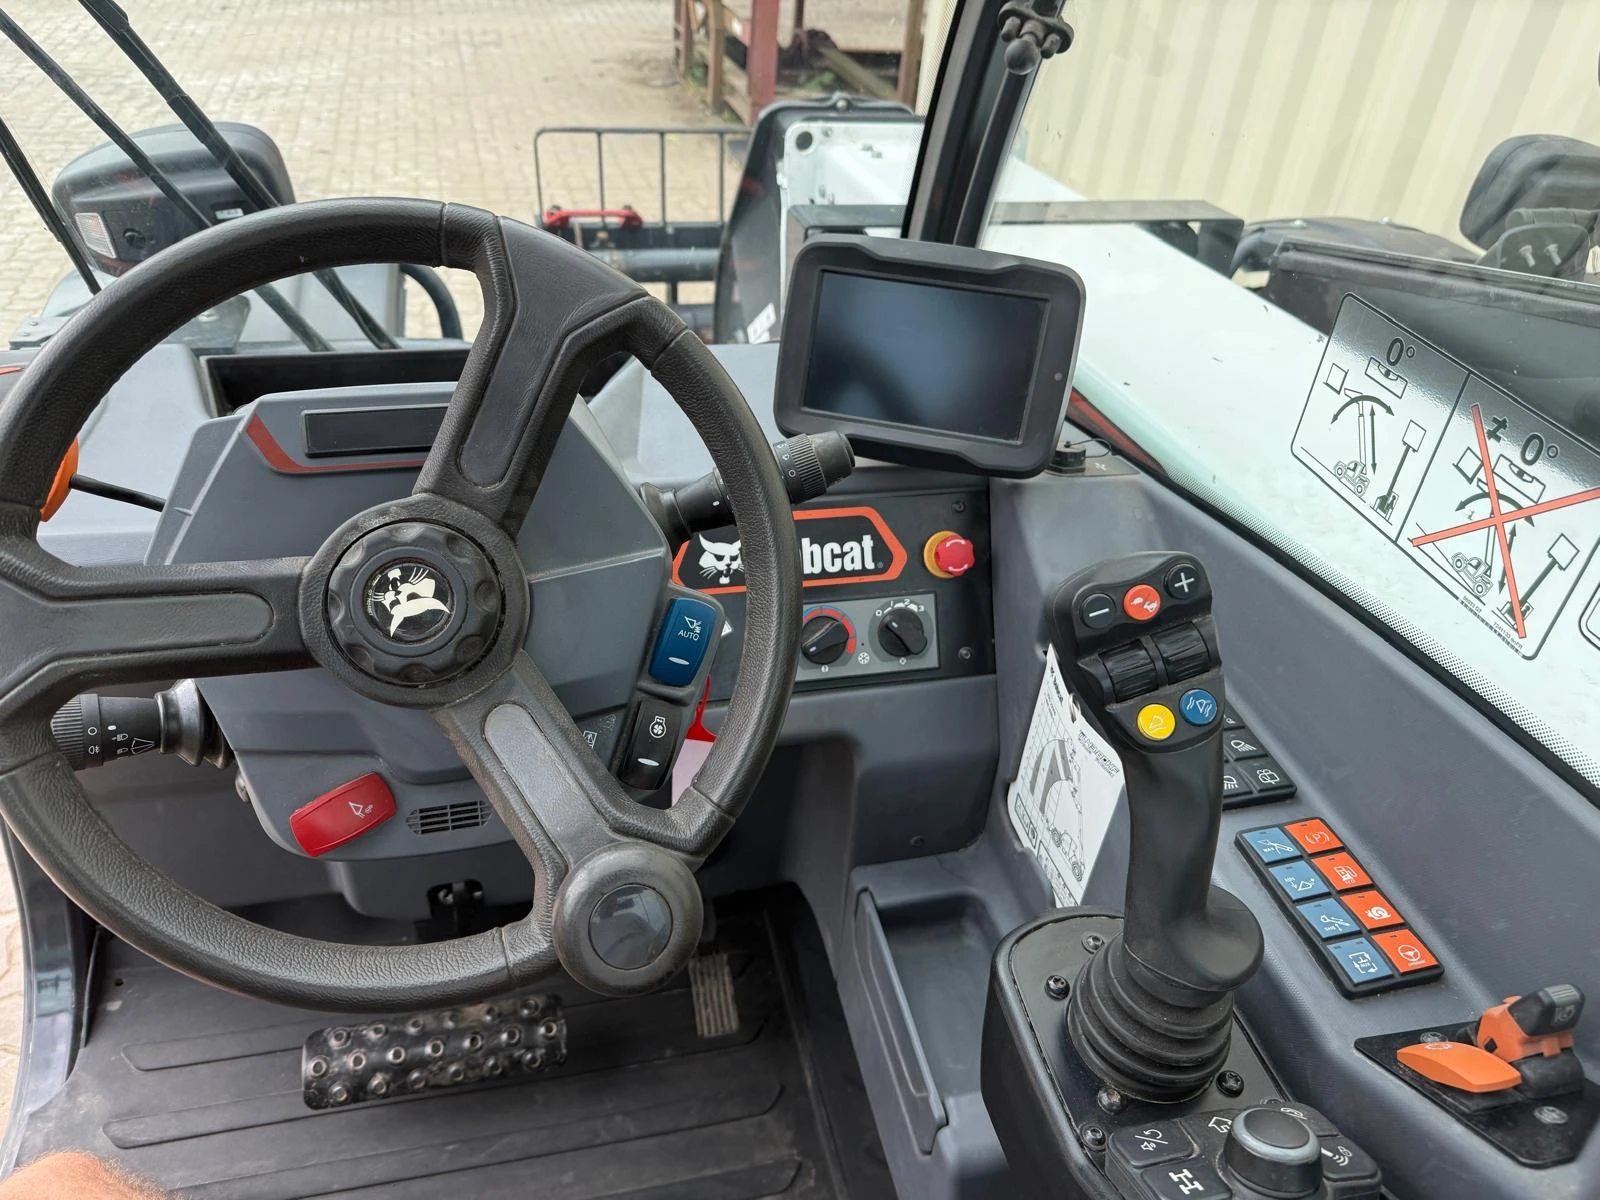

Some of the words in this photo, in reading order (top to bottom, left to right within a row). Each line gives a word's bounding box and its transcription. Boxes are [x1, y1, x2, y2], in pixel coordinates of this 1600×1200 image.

[1387, 338, 1415, 366] 0°
[800, 535, 875, 574] bcat
[678, 629, 700, 641] AUTO
